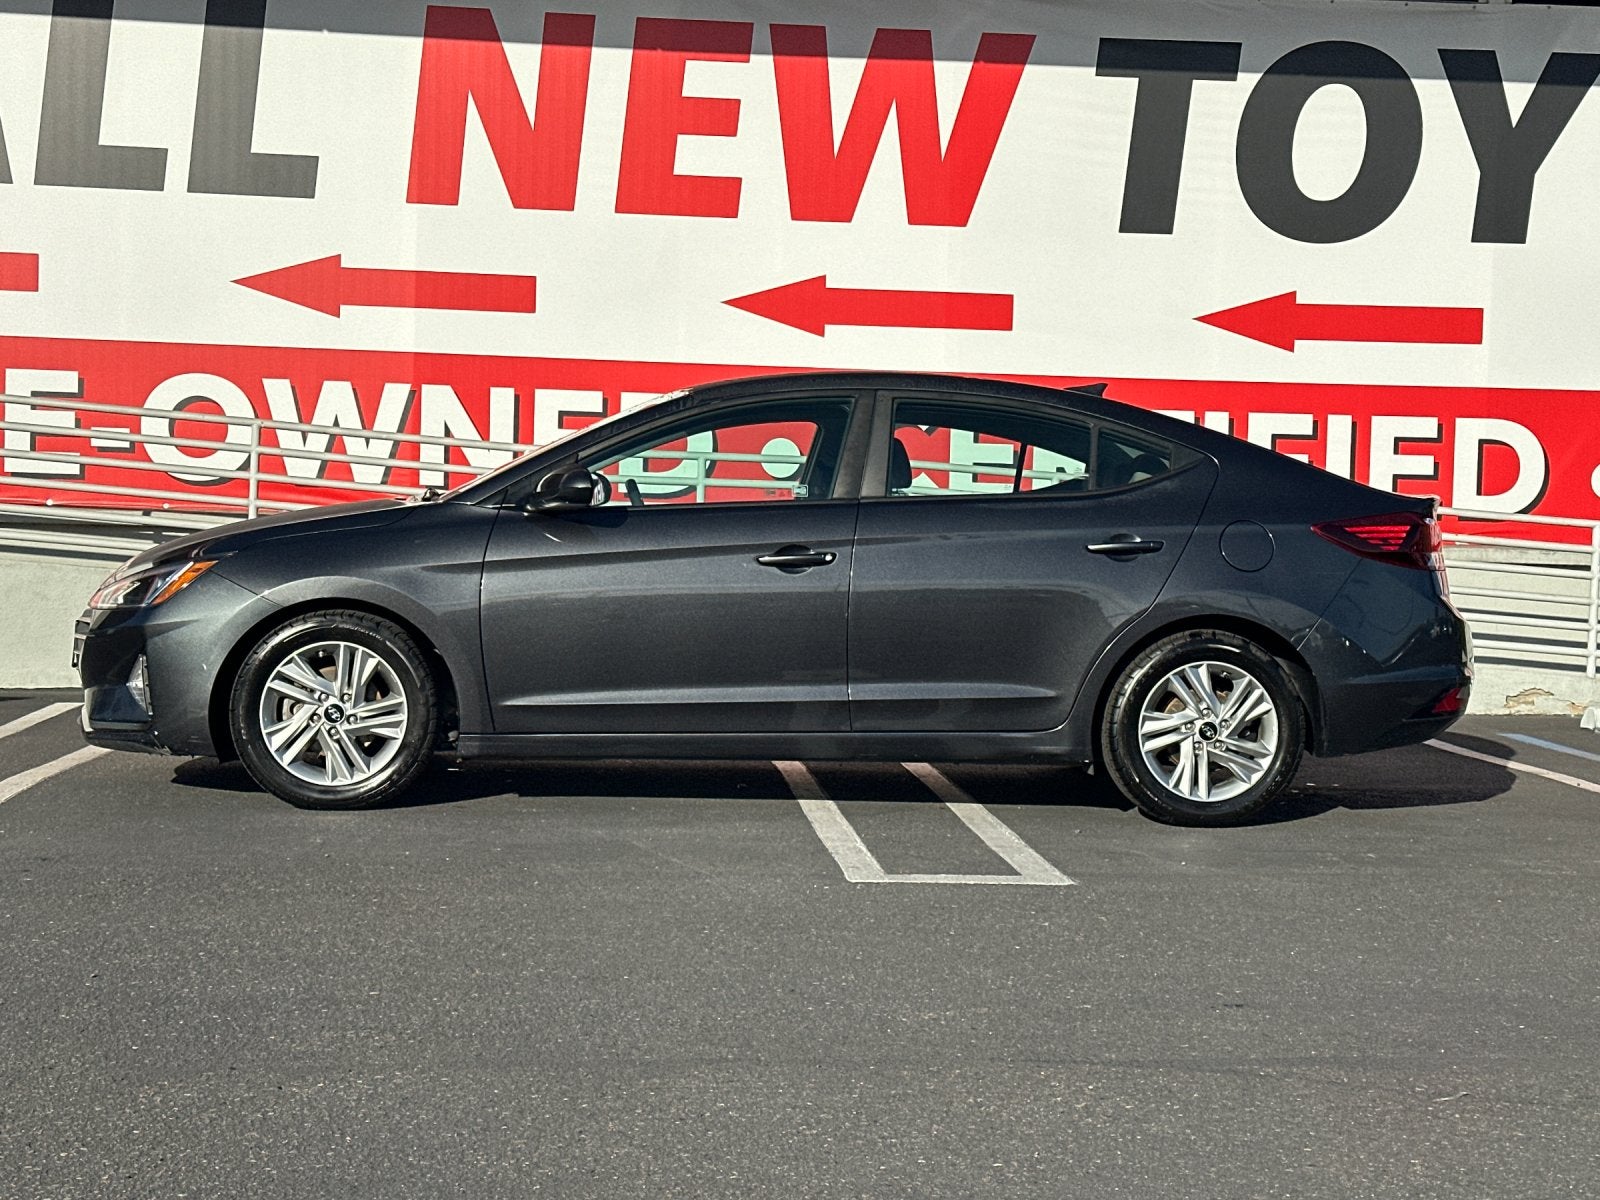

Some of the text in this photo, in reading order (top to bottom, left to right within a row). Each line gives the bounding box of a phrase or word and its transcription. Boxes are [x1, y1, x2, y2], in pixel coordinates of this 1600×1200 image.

[0, 0, 1600, 244] LL NEW TOY
